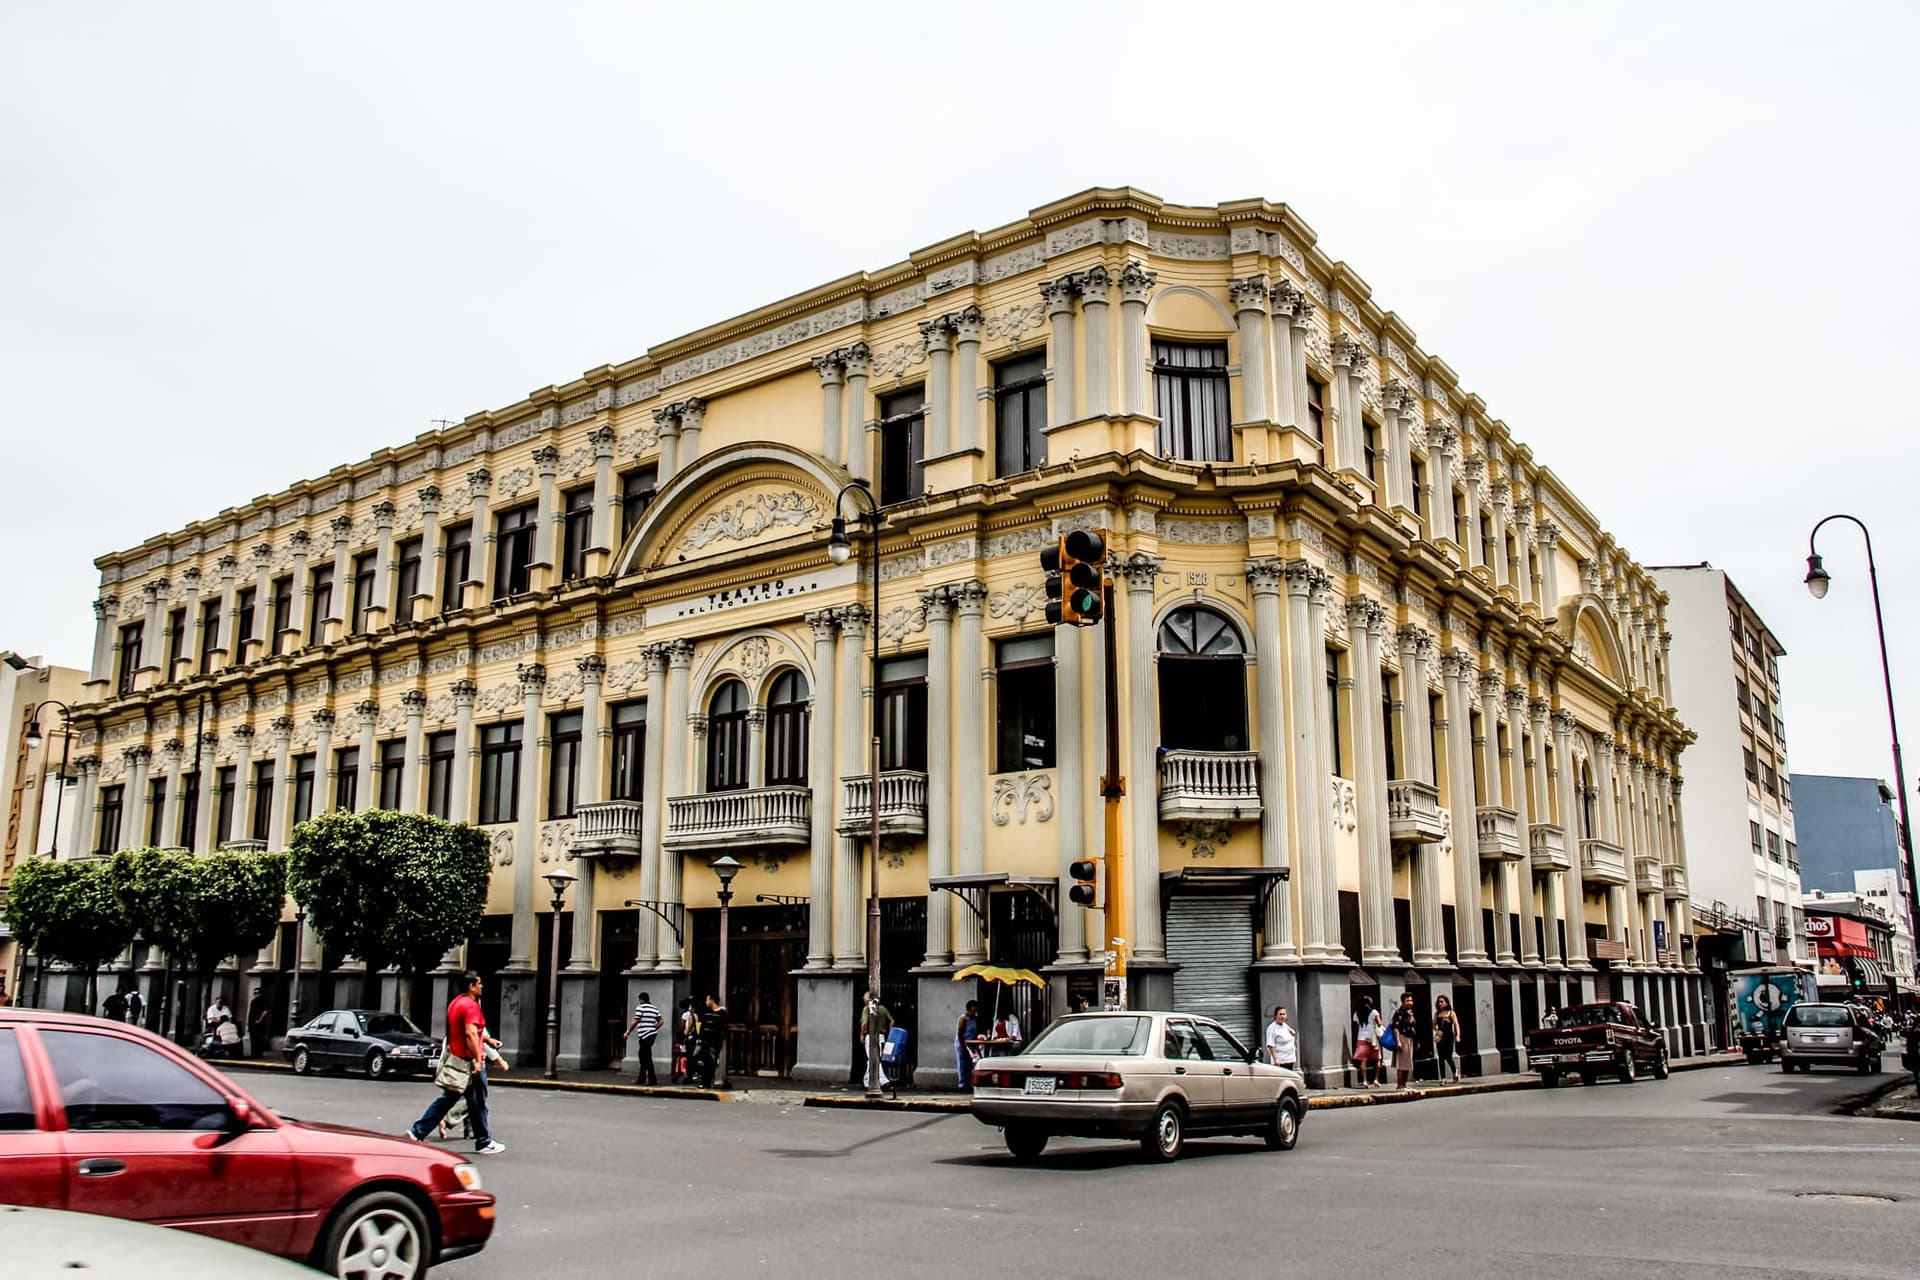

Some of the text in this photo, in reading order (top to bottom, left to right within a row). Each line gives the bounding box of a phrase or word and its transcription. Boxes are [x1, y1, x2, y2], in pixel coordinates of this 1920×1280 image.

[1186, 571, 1209, 586] 1928
[708, 580, 784, 604] TEATRO
[742, 583, 817, 604] SALAZAR
[1553, 1037, 1582, 1045] TOYOTA
